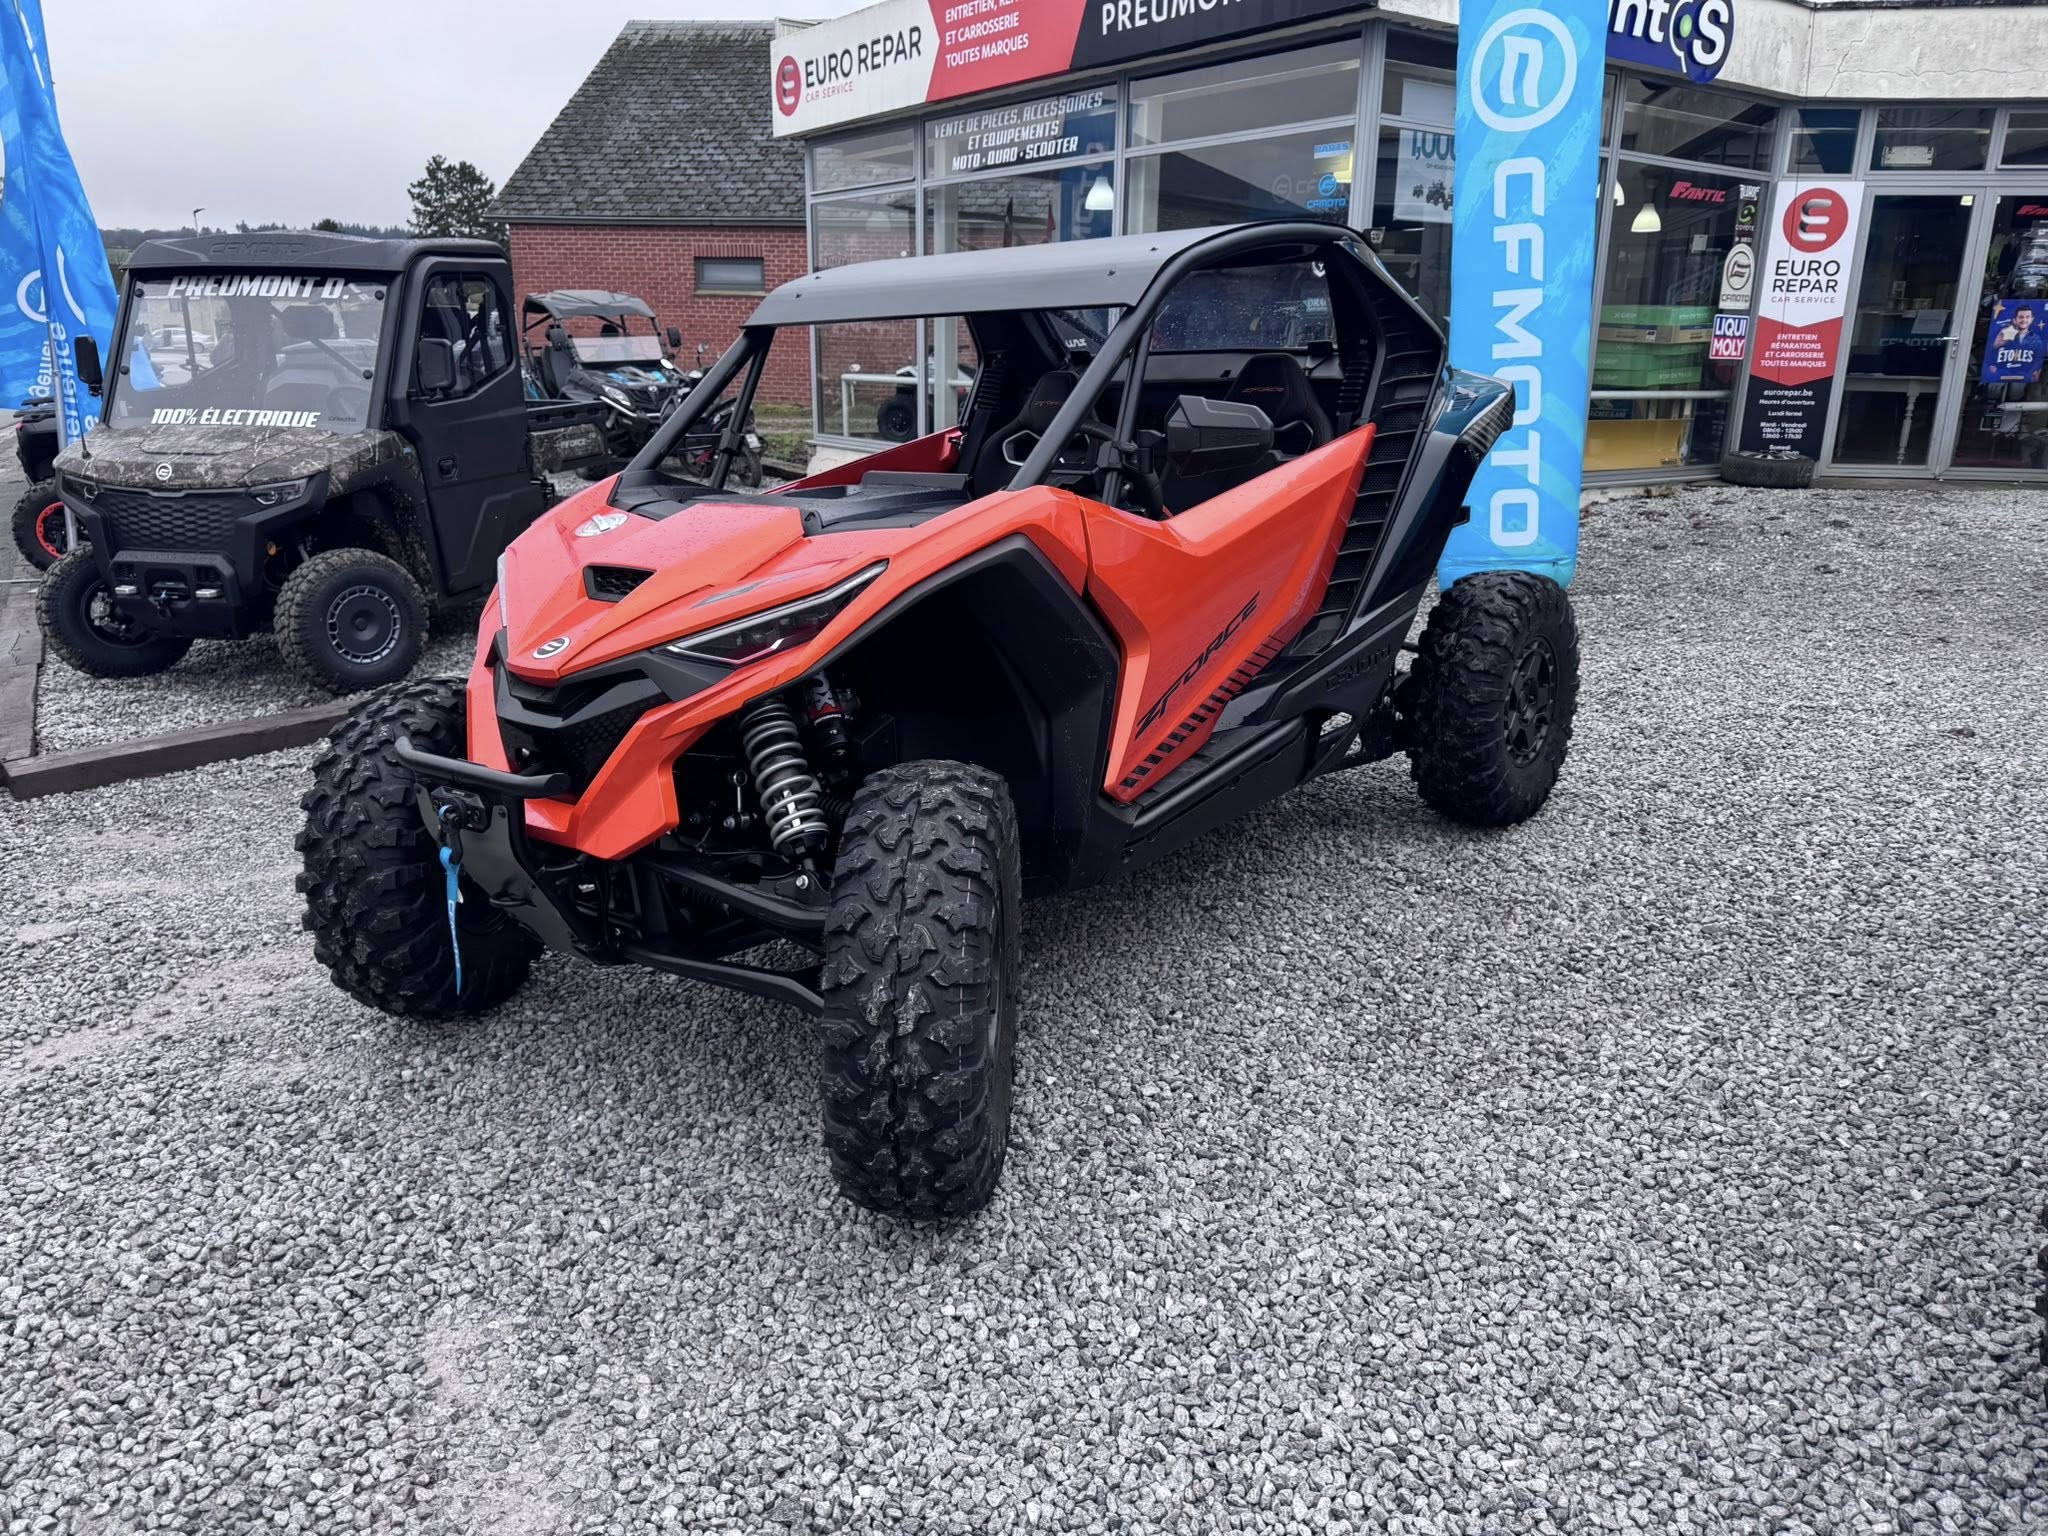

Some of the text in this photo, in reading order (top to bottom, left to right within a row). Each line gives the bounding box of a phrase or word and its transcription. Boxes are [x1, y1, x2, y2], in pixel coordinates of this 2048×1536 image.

[945, 11, 1020, 46] ET CARROSSERIE
[804, 26, 922, 89] EURO REPAR
[945, 33, 1029, 68] TOUTES MARQUES
[805, 81, 854, 103] CAR SERVICE
[935, 118, 965, 139] VENTE
[966, 117, 979, 133] DE
[1022, 91, 1103, 122] ACCESSOIRES
[968, 120, 1060, 151] ET EQUIPEMENTS
[952, 135, 1079, 171] MOTO QUAD SCOOTER
[1669, 181, 1727, 202] FANTIC
[1775, 259, 1841, 277] EURO
[167, 274, 350, 300] PREUMONT D.
[1772, 278, 1838, 293] REPAR
[1770, 296, 1836, 304] CAR SERVICE
[1716, 317, 1748, 337] LIQUI
[1776, 333, 1819, 341] ENTRETIEN
[1489, 157, 1545, 547] CFMOTO
[1711, 338, 1746, 357] MOLY
[1765, 351, 1825, 359] ET CARROSSERIE
[1770, 342, 1822, 350] RÉPARATIONS
[1760, 359, 1827, 368] TOUTES MARQUES
[1763, 388, 1814, 397] eurorepar.be
[151, 406, 321, 429] 100% ÉLECTRIQUE
